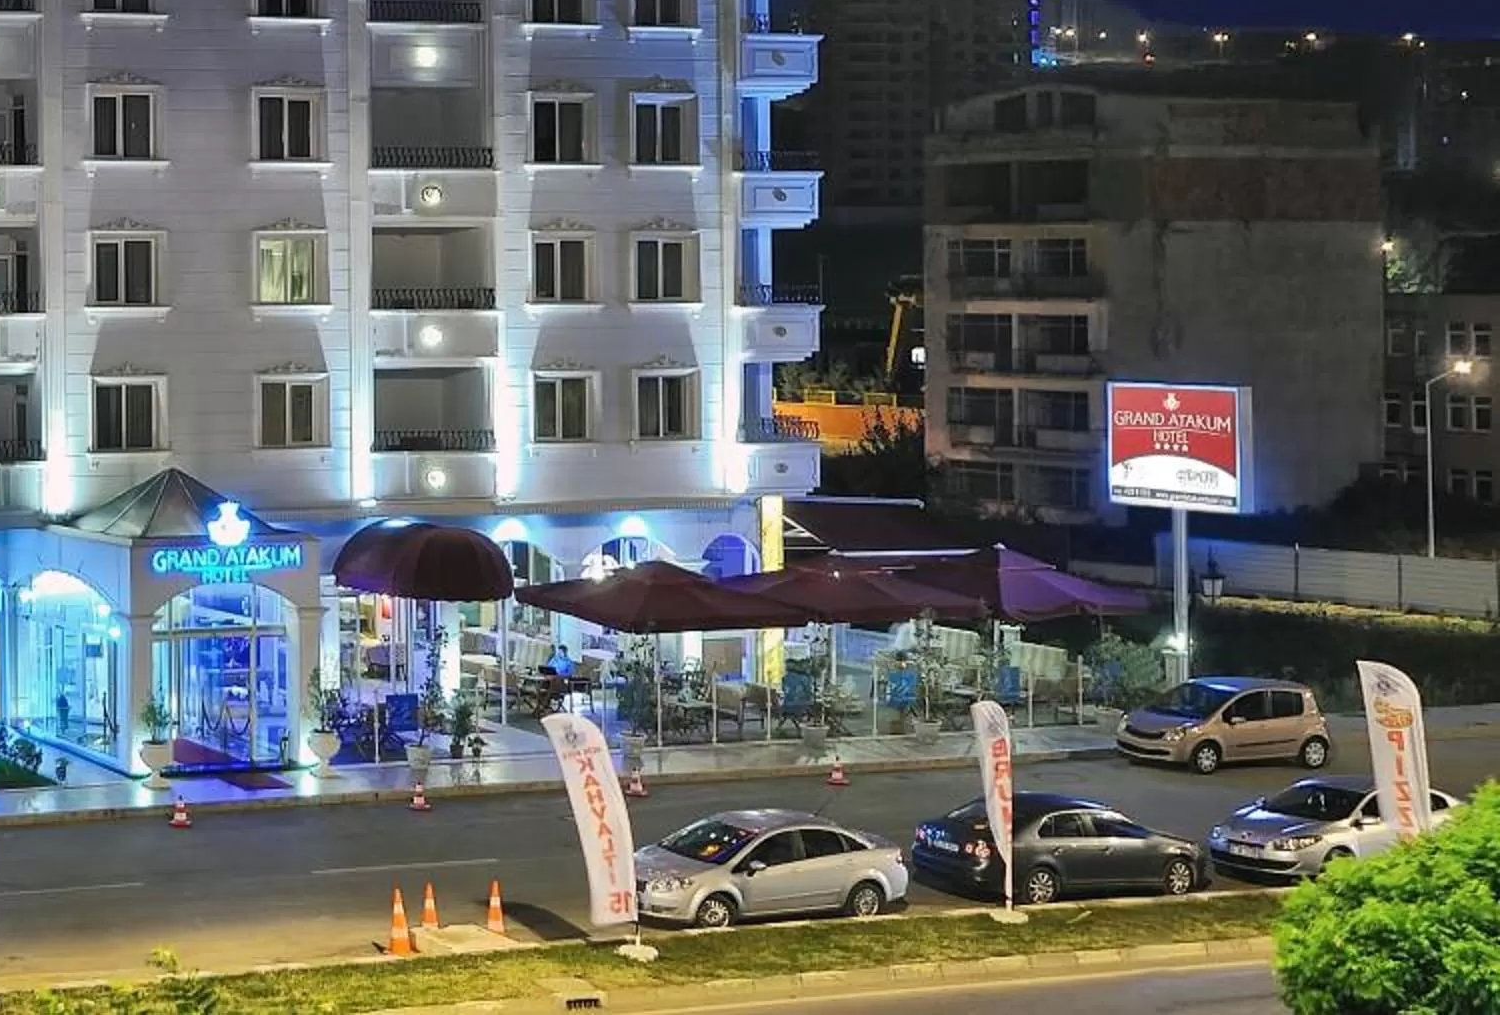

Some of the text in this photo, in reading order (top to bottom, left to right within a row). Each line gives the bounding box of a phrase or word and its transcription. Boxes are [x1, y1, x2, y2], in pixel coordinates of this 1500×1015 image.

[1114, 410, 1232, 433] GRAND ATAKUM
[1153, 429, 1189, 444] HOTEL
[153, 545, 301, 573] GRAND ATAKUM
[201, 568, 250, 584] HOTEL
